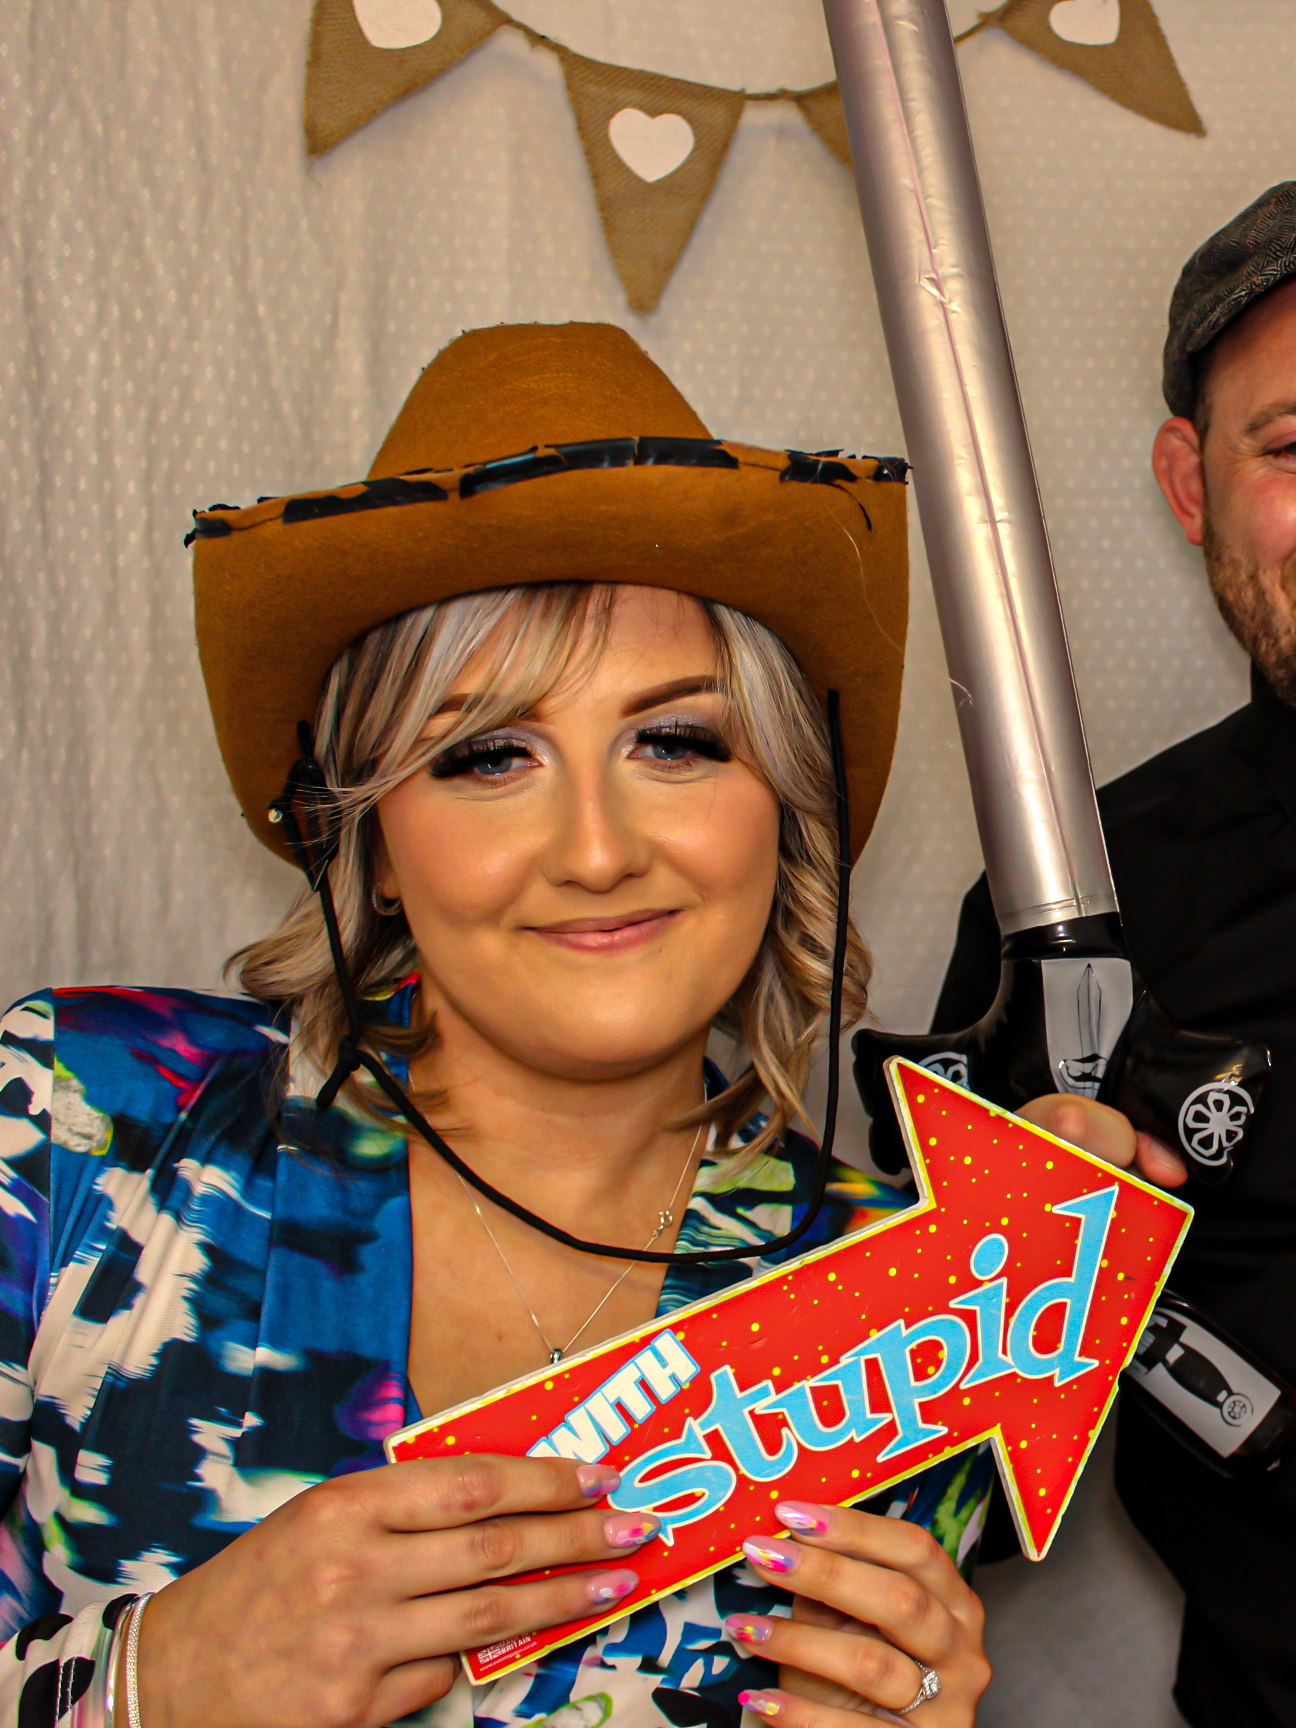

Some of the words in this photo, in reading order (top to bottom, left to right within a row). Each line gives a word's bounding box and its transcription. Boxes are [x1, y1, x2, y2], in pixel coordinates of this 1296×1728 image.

[526, 1328, 701, 1465] WITH
[607, 1185, 1120, 1546] stupid
[500, 1636, 532, 1655] BRITAIN
